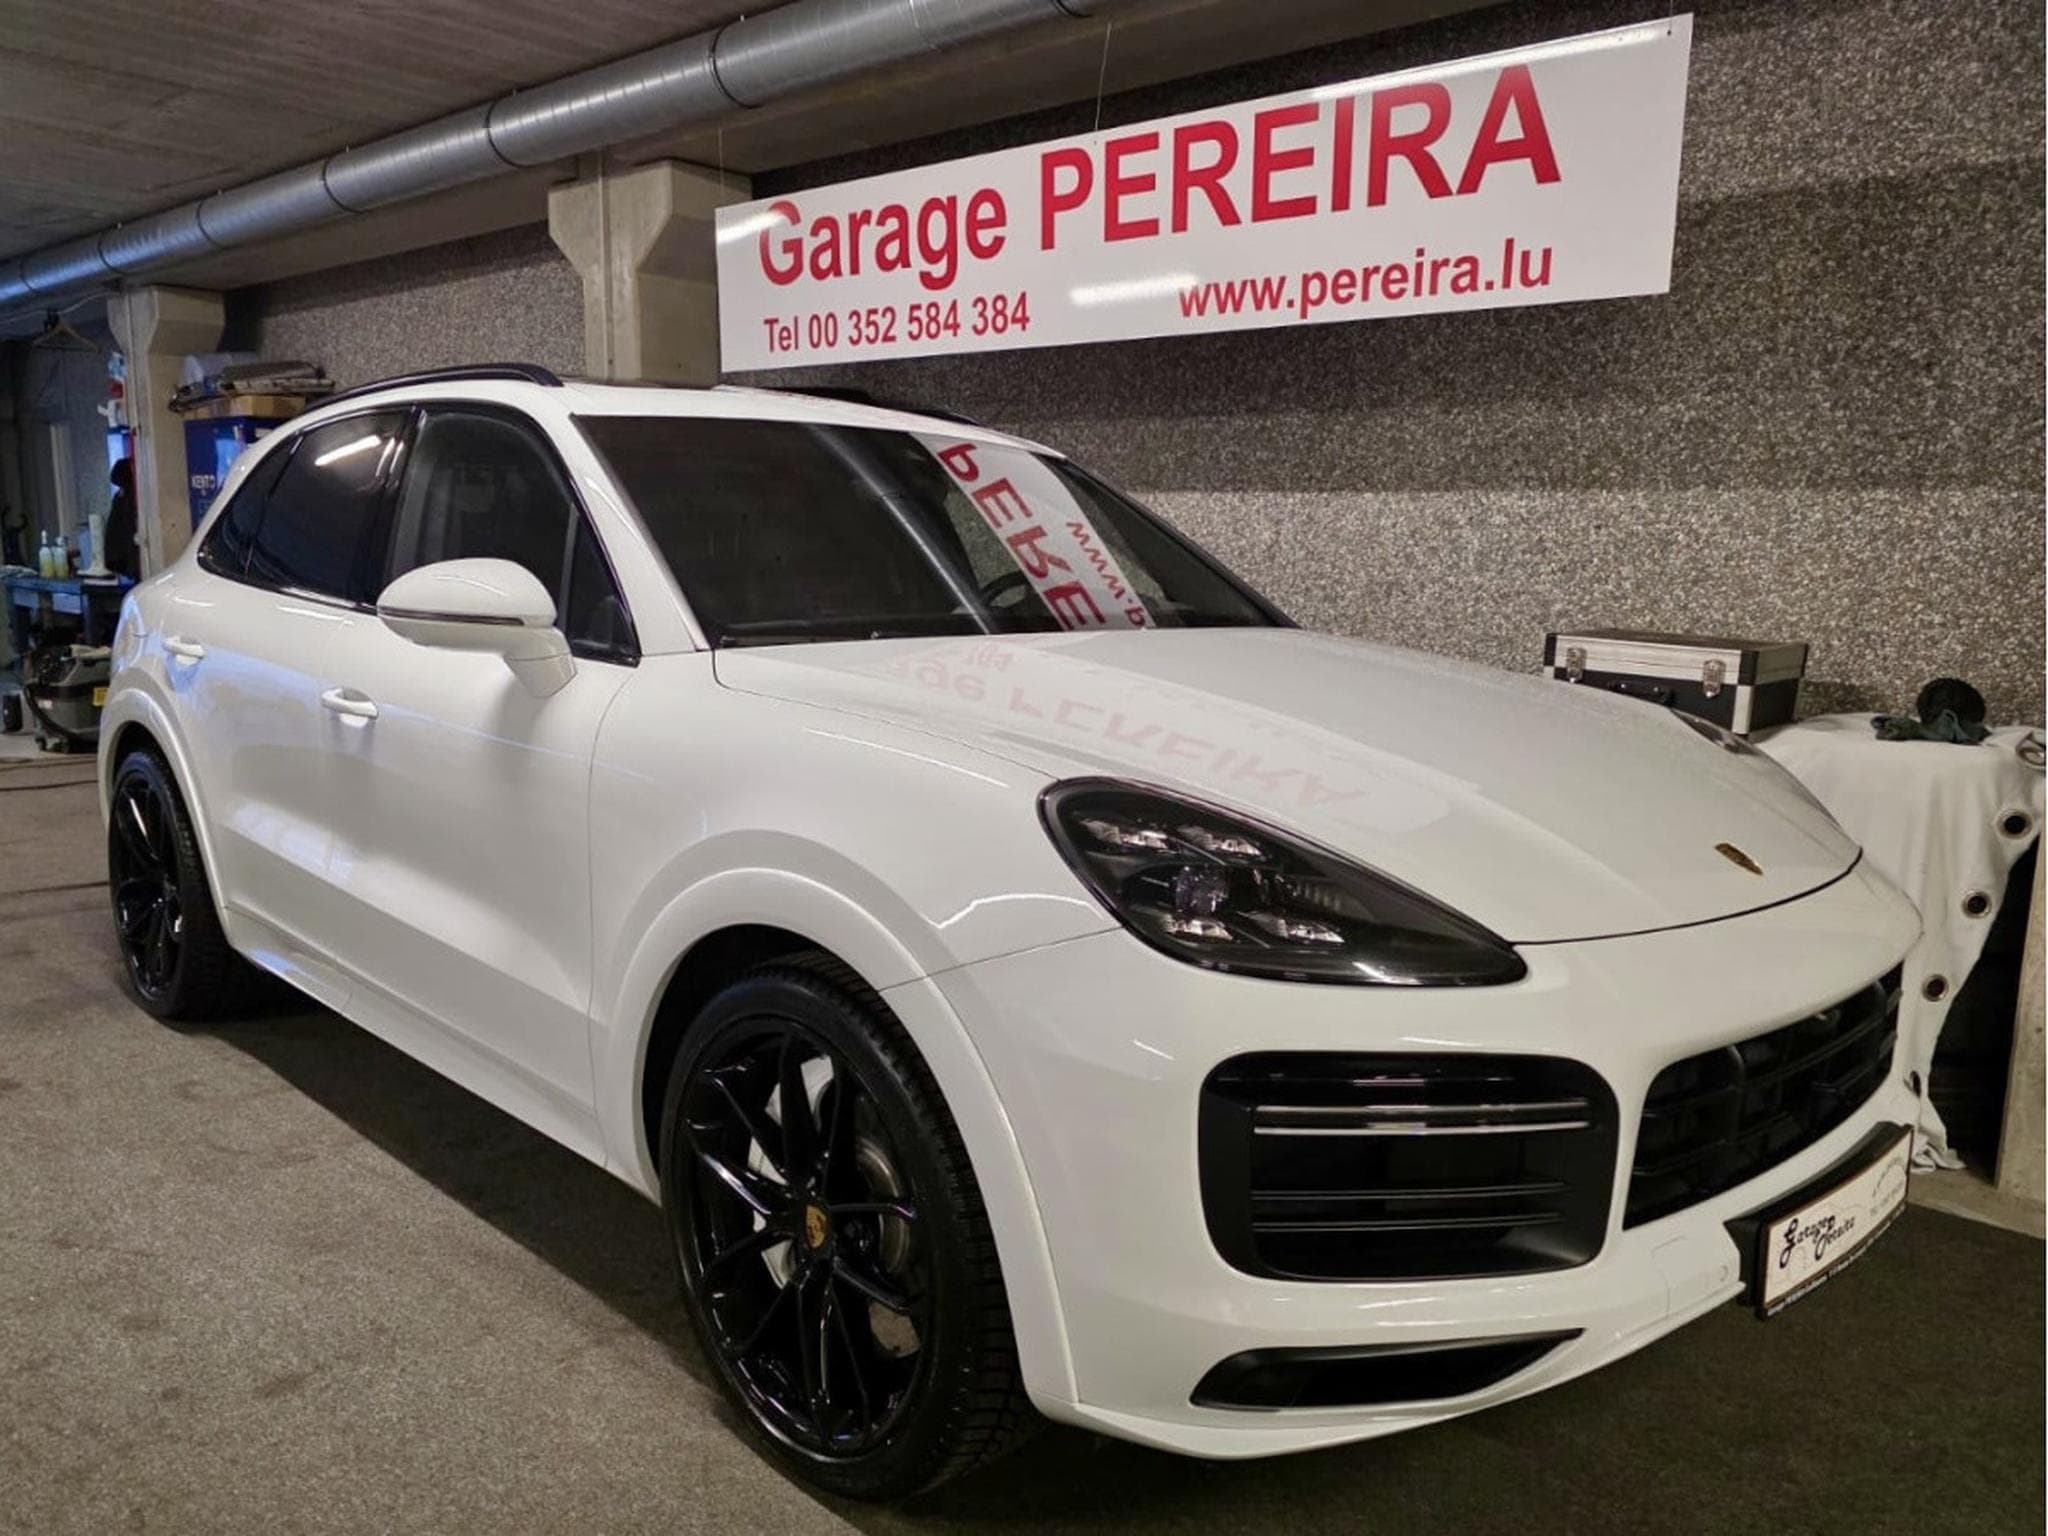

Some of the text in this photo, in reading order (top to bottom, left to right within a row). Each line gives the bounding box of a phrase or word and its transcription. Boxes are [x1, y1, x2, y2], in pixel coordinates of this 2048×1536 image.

[759, 64, 1563, 292] Garage PEREIRA
[1179, 237, 1554, 320] www.pereira.lu
[764, 291, 1031, 353] Tel 00 352 584 384
